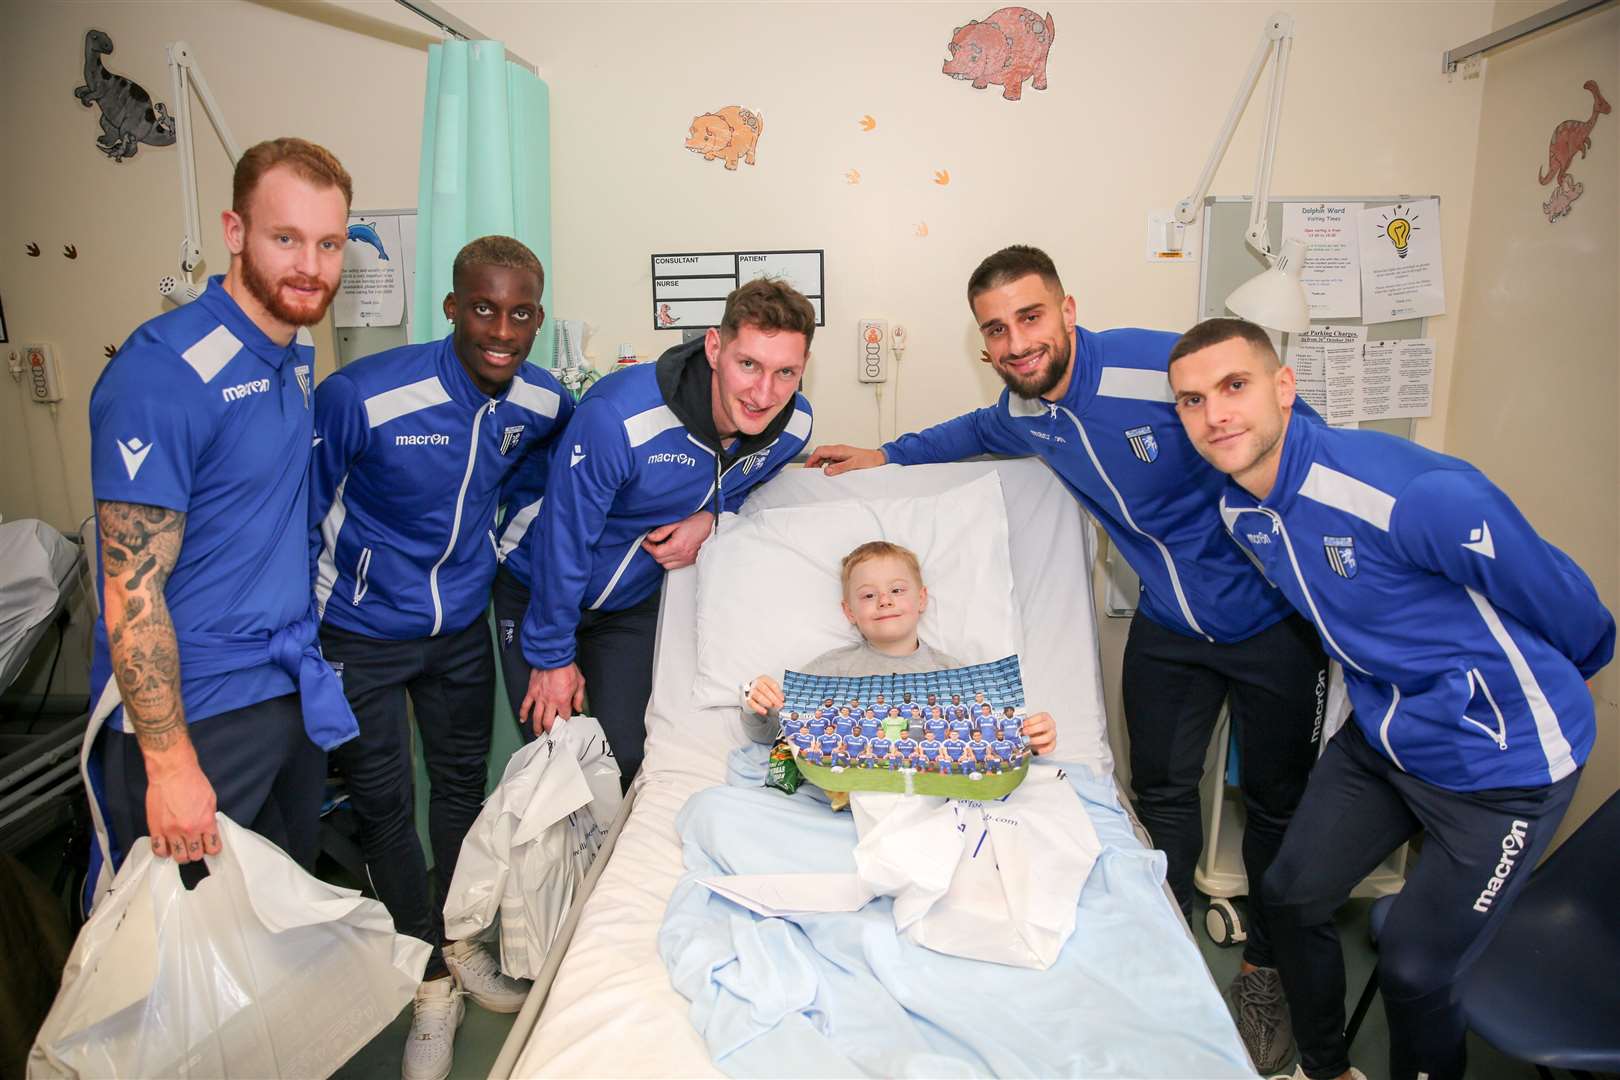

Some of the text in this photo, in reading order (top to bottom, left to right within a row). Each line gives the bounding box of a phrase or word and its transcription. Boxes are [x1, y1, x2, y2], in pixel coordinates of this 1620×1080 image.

[655, 257, 699, 265] CONSULTANT
[395, 434, 450, 445] macron
[648, 453, 696, 467] macron
[1310, 669, 1326, 743] macron
[1473, 820, 1528, 912] macron
